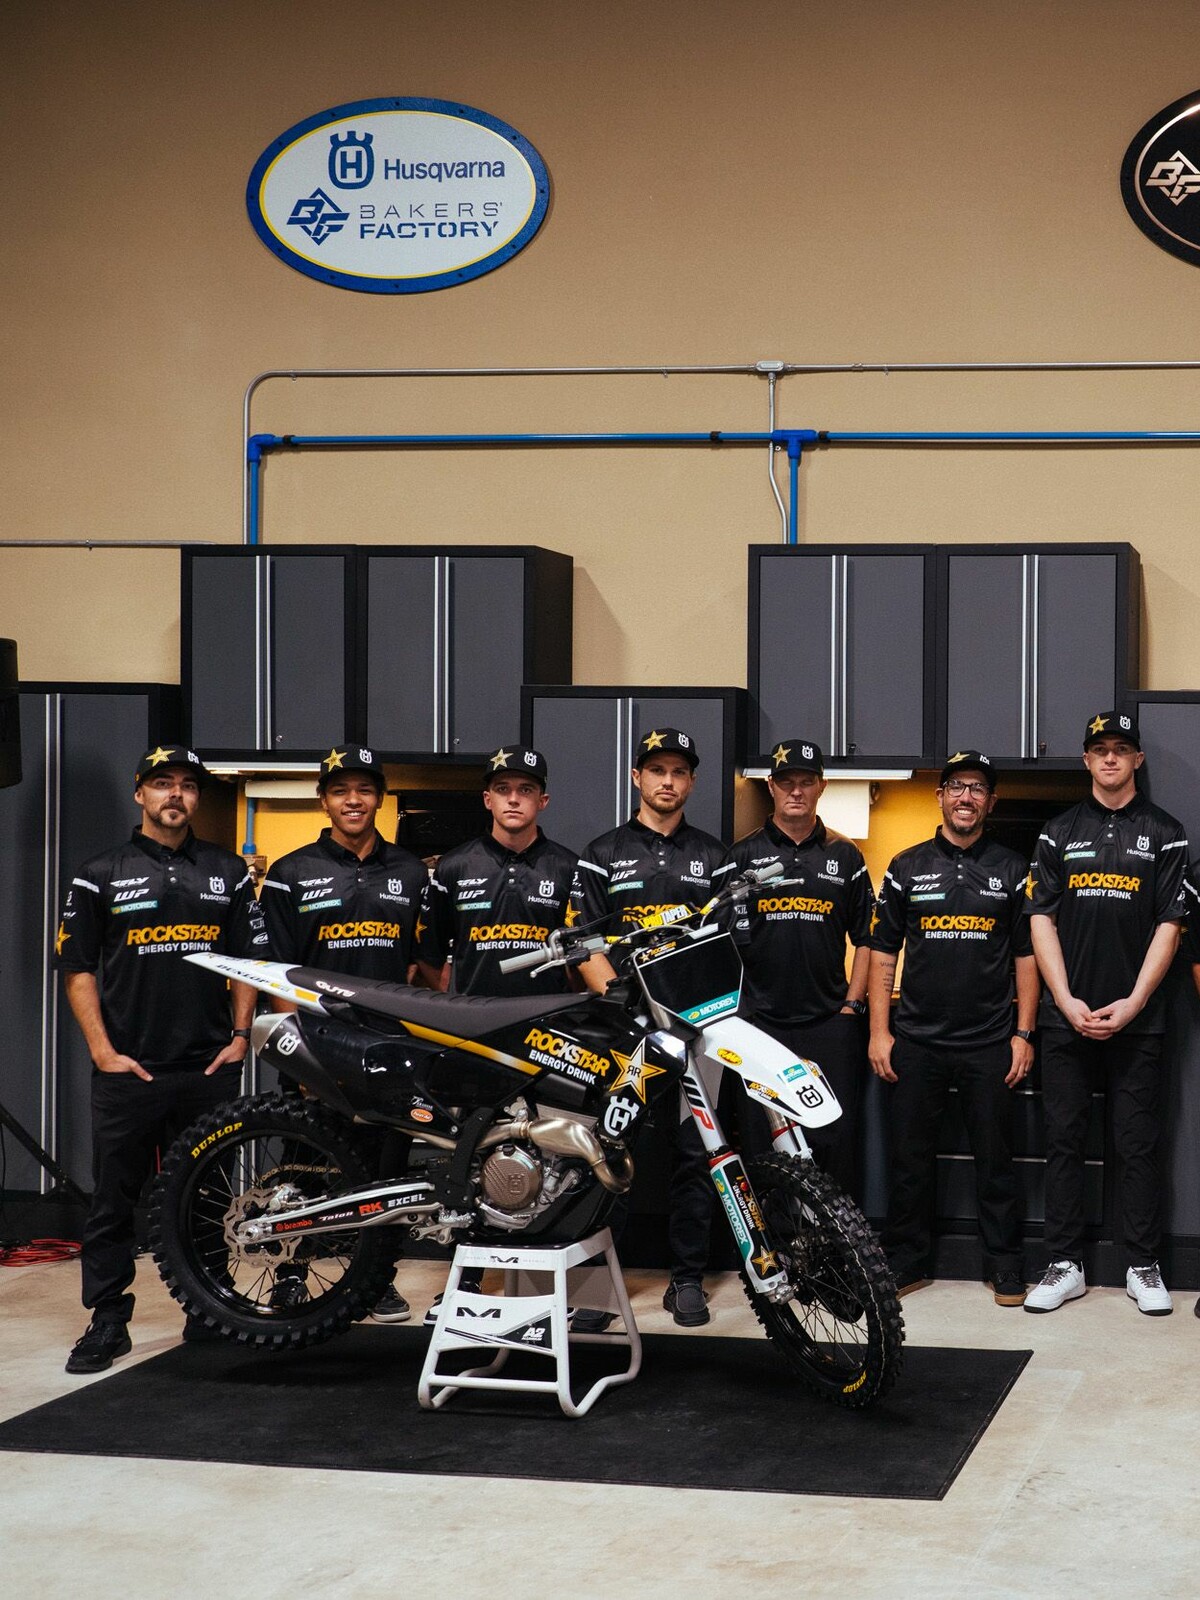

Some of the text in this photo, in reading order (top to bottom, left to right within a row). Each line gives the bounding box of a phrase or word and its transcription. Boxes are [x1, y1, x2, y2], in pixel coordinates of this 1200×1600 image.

[384, 159, 506, 182] Husqvarna
[360, 221, 499, 239] FACTORY
[1068, 872, 1141, 891] ROCKSTAR
[1077, 889, 1132, 900] ENERGY DRINK
[757, 897, 834, 915] ROCKSTAR
[766, 912, 825, 923] ENERGY DRINK
[920, 915, 996, 932] ROCKSTAR
[126, 924, 220, 946] ROCKSTAR
[318, 920, 401, 941] ROCKSTAR
[469, 924, 550, 942] ROCKSTAR
[925, 931, 988, 940] ENERGY DRINK
[137, 942, 212, 955] ENERGY DRINK
[328, 938, 394, 949] ENERGY DRINK
[476, 941, 546, 951] ENERGY DRINK
[699, 995, 736, 1016] MOTOREX
[524, 1028, 611, 1077] ROCKSTAR
[529, 1049, 597, 1085] ENERGY DRINK
[191, 1121, 243, 1159] DUNLOP
[284, 1218, 314, 1231] brembo
[358, 1201, 384, 1216] RK
[387, 1193, 426, 1208] EXCEL
[721, 1193, 749, 1246] MOTOREX
[743, 1207, 756, 1230] DRINK
[525, 1327, 546, 1338] A2
